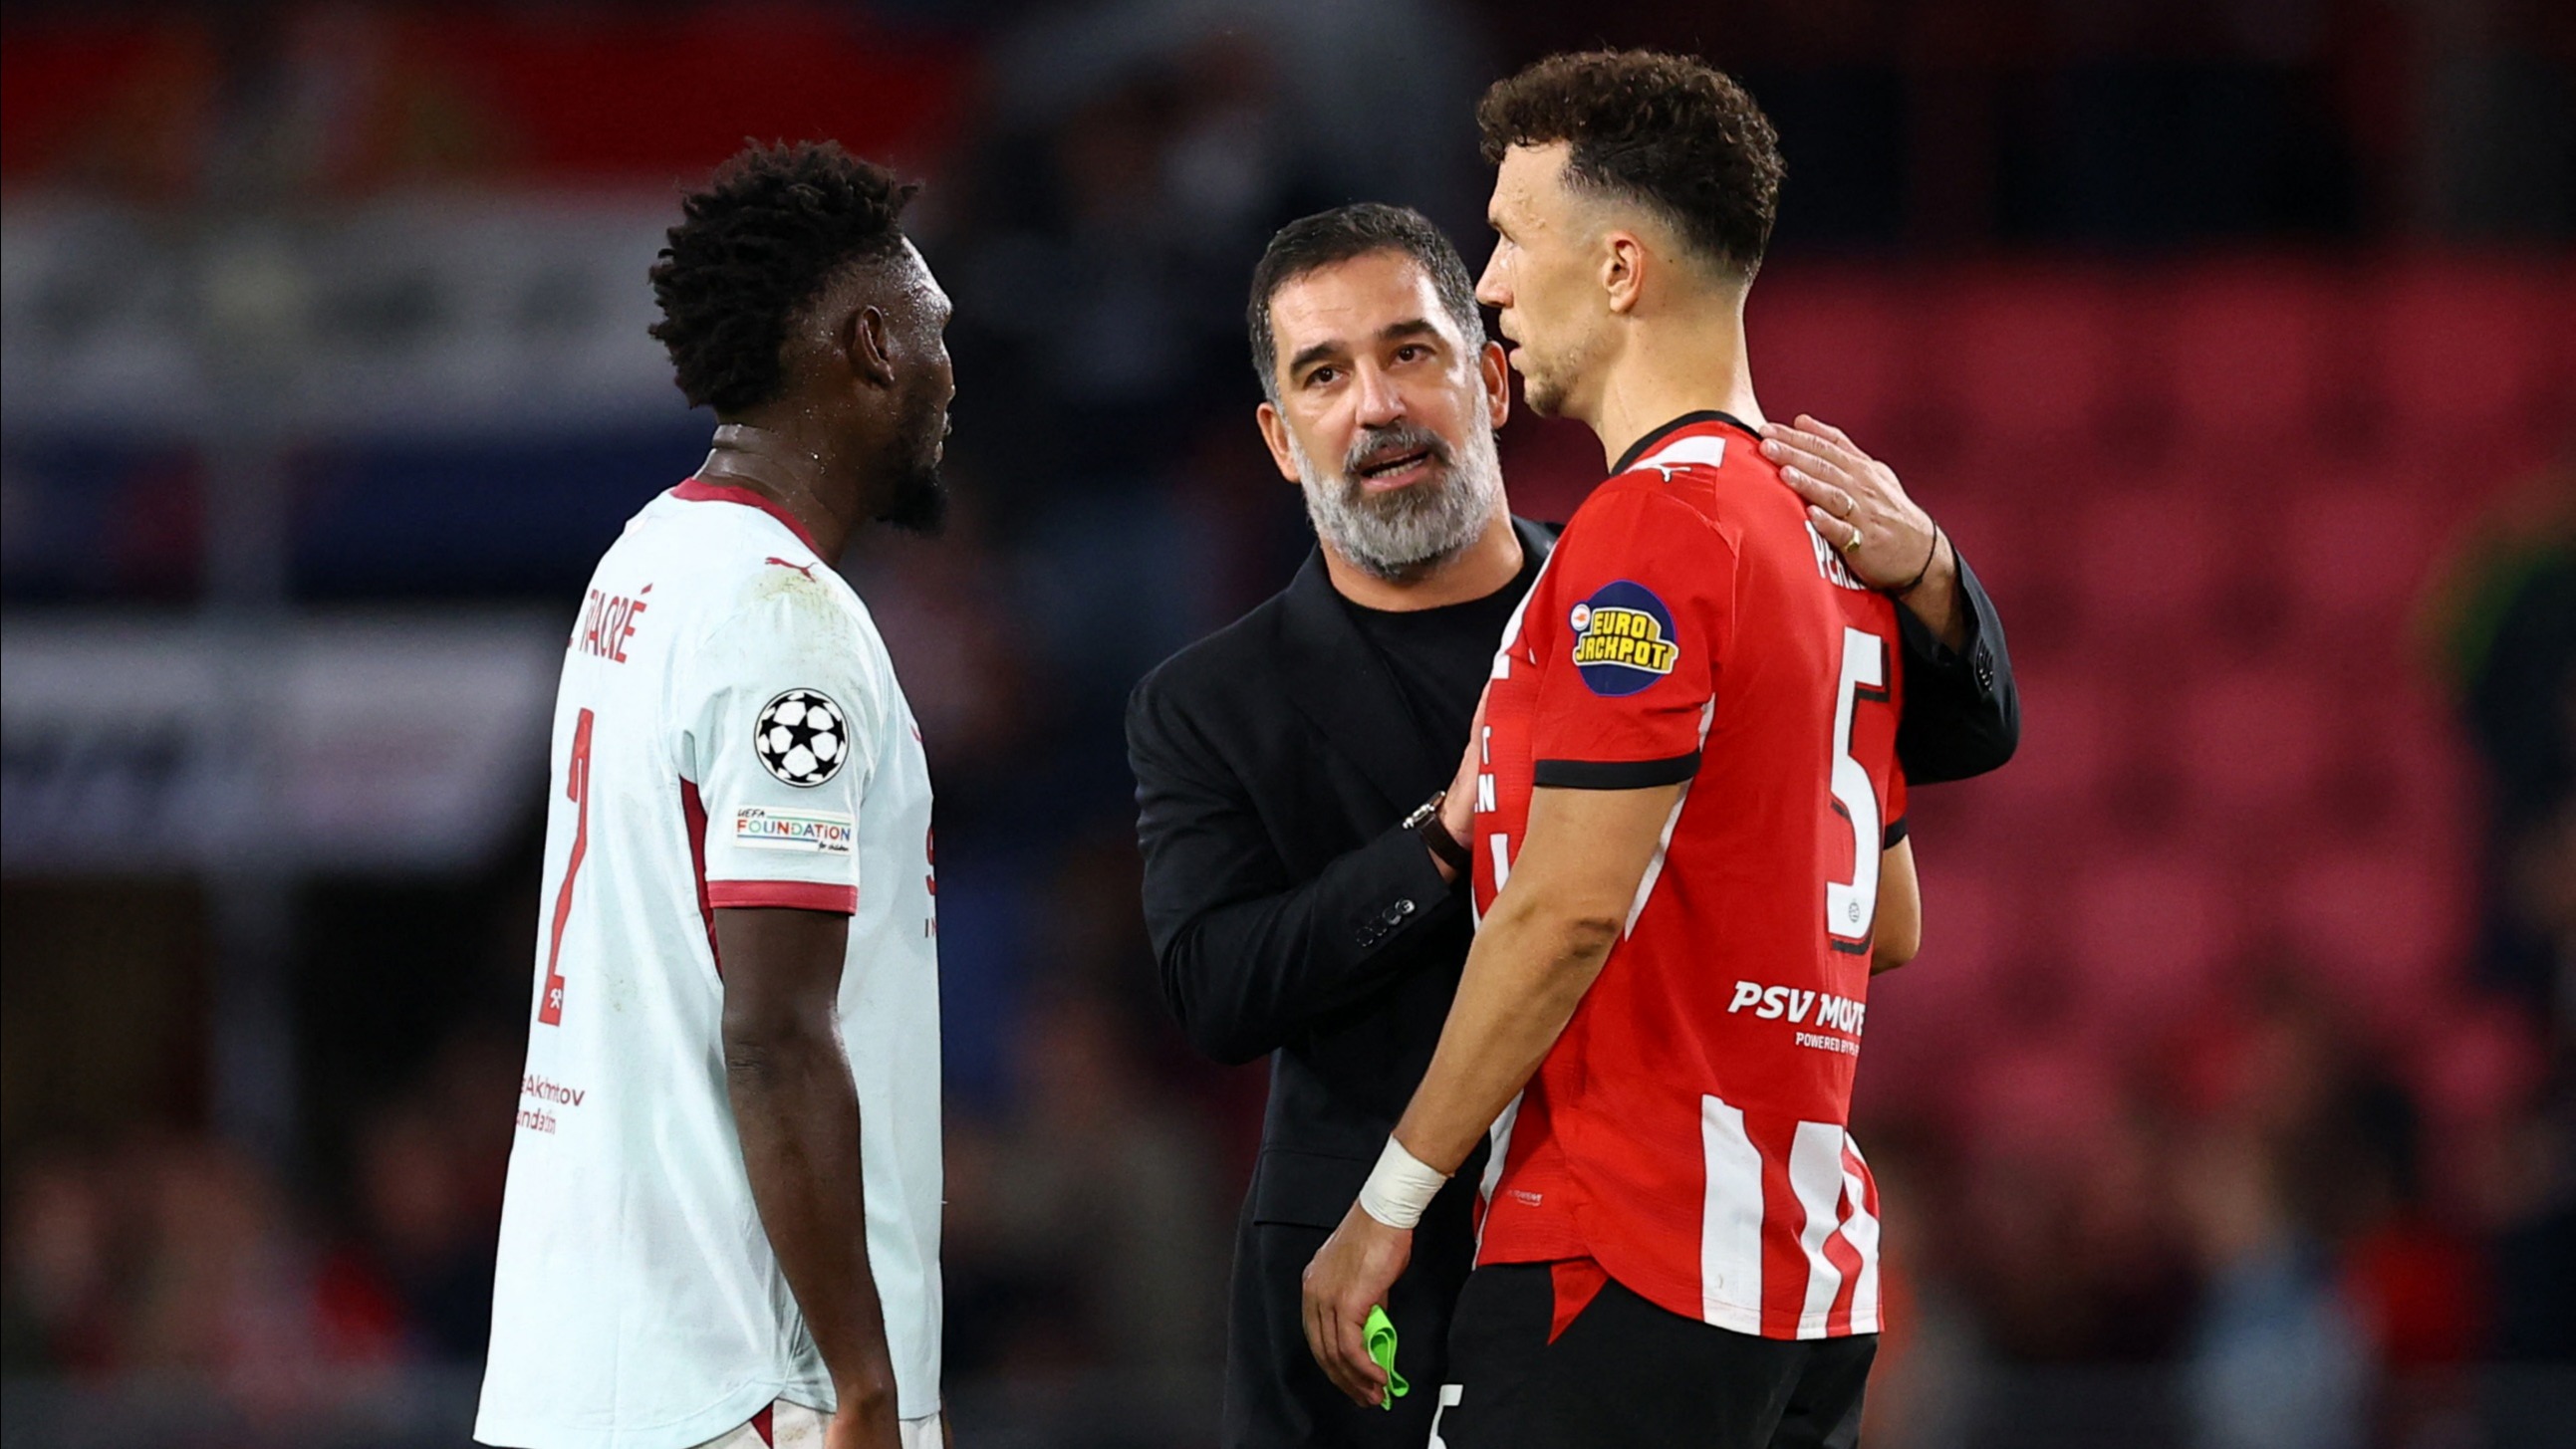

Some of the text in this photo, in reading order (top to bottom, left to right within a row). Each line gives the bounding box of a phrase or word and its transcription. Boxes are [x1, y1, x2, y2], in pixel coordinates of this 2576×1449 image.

[1593, 611, 1650, 639] EURO
[1575, 635, 1669, 669] JACKPOT
[1826, 625, 1889, 953] 5
[737, 809, 765, 818] UEFA
[538, 707, 595, 1027] 2
[1727, 980, 1816, 1024] PSV
[1795, 1032, 1840, 1053] POWERED
